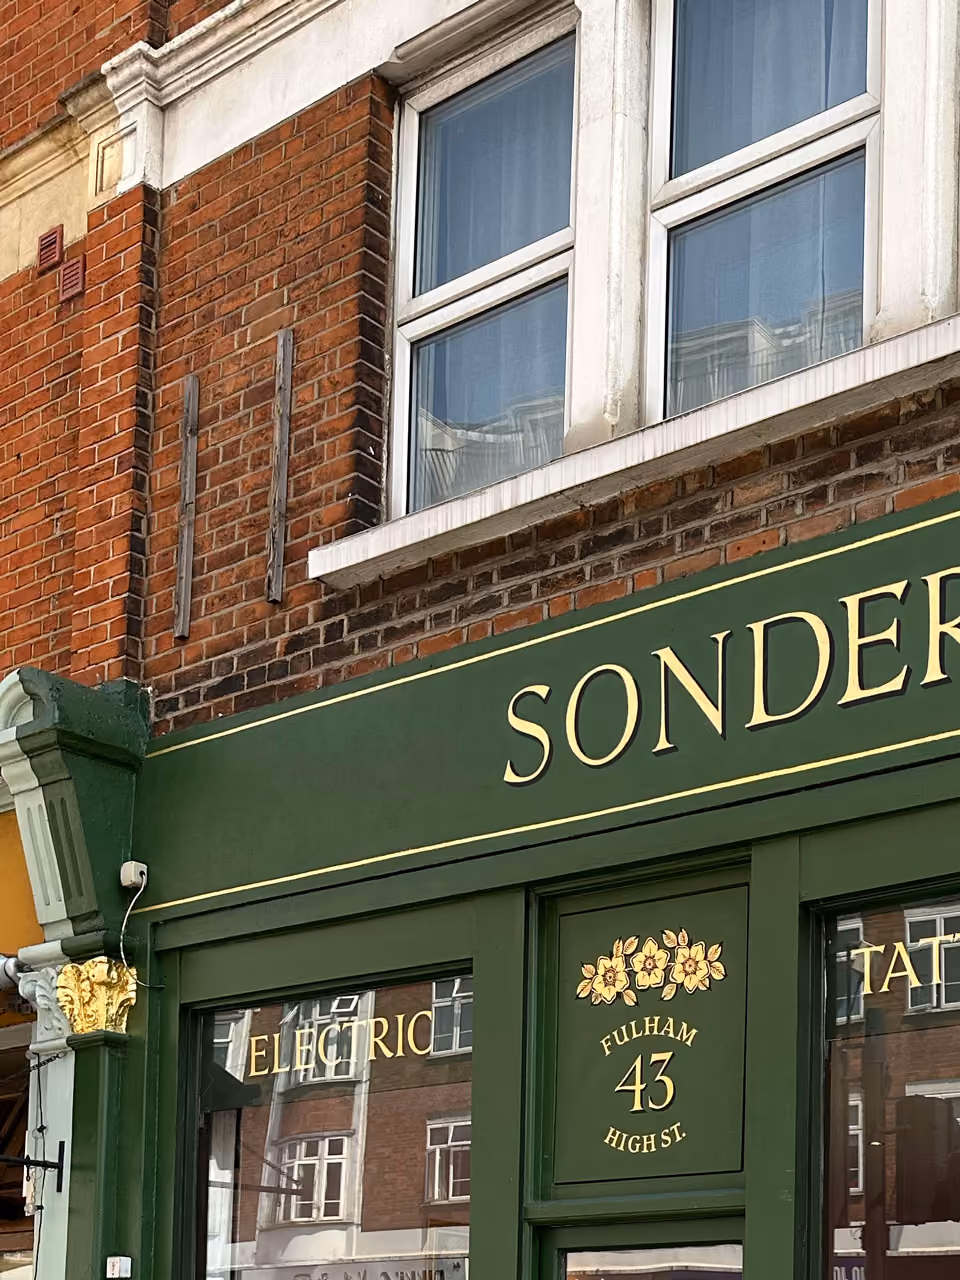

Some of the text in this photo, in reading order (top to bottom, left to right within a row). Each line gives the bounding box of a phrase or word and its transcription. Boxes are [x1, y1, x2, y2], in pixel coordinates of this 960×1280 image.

[248, 1010, 433, 1077] ELECTRIC
[600, 1016, 699, 1056] FULHAM
[614, 1051, 676, 1112] 43
[603, 1122, 687, 1153] HIGH ST.
